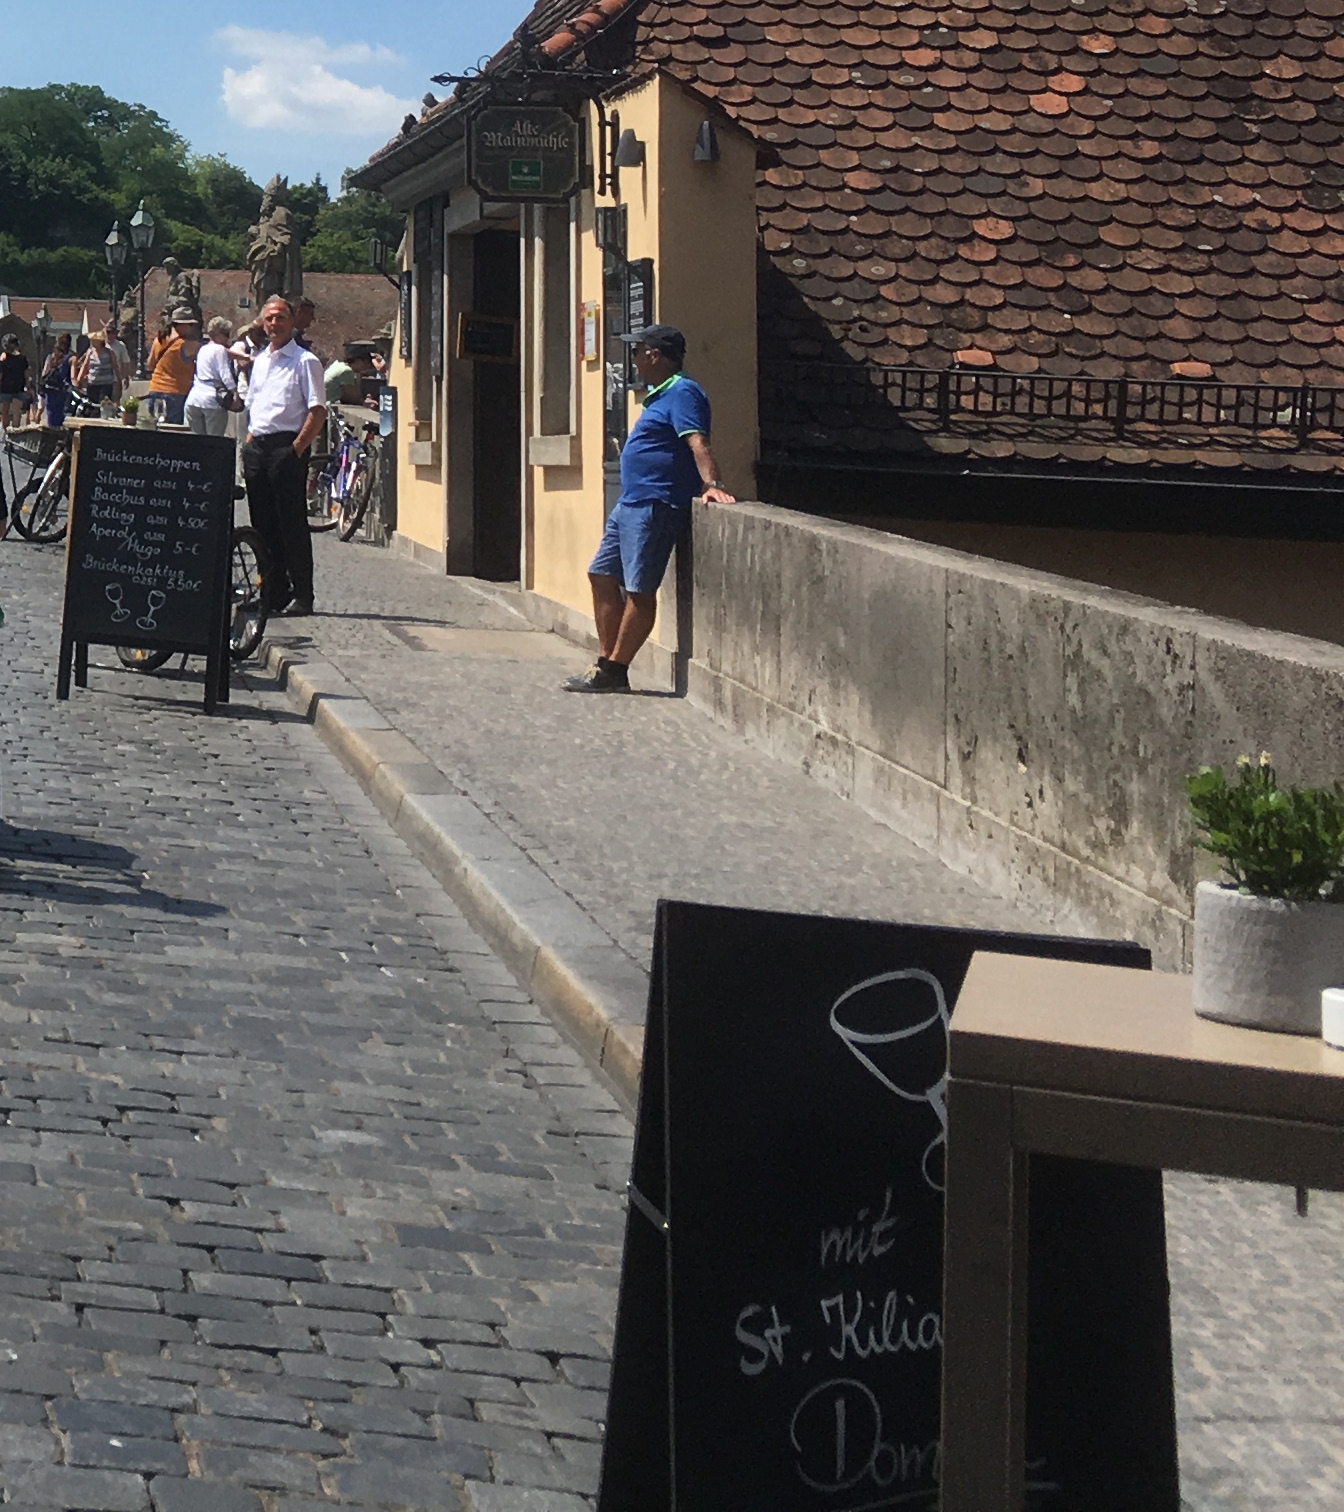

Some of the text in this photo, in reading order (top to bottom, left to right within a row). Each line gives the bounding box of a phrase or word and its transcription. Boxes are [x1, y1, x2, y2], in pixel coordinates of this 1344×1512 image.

[512, 119, 540, 136] Alte
[481, 131, 570, 152] Mainmühle
[93, 447, 201, 473] Brückenschoppen
[95, 469, 146, 488] Silvaner
[91, 486, 145, 506] Bacchus
[81, 553, 185, 578] Brückenkaktus
[820, 1186, 900, 1267] mit
[734, 1289, 944, 1376] St. Kilia
[790, 1377, 944, 1492] Dom
